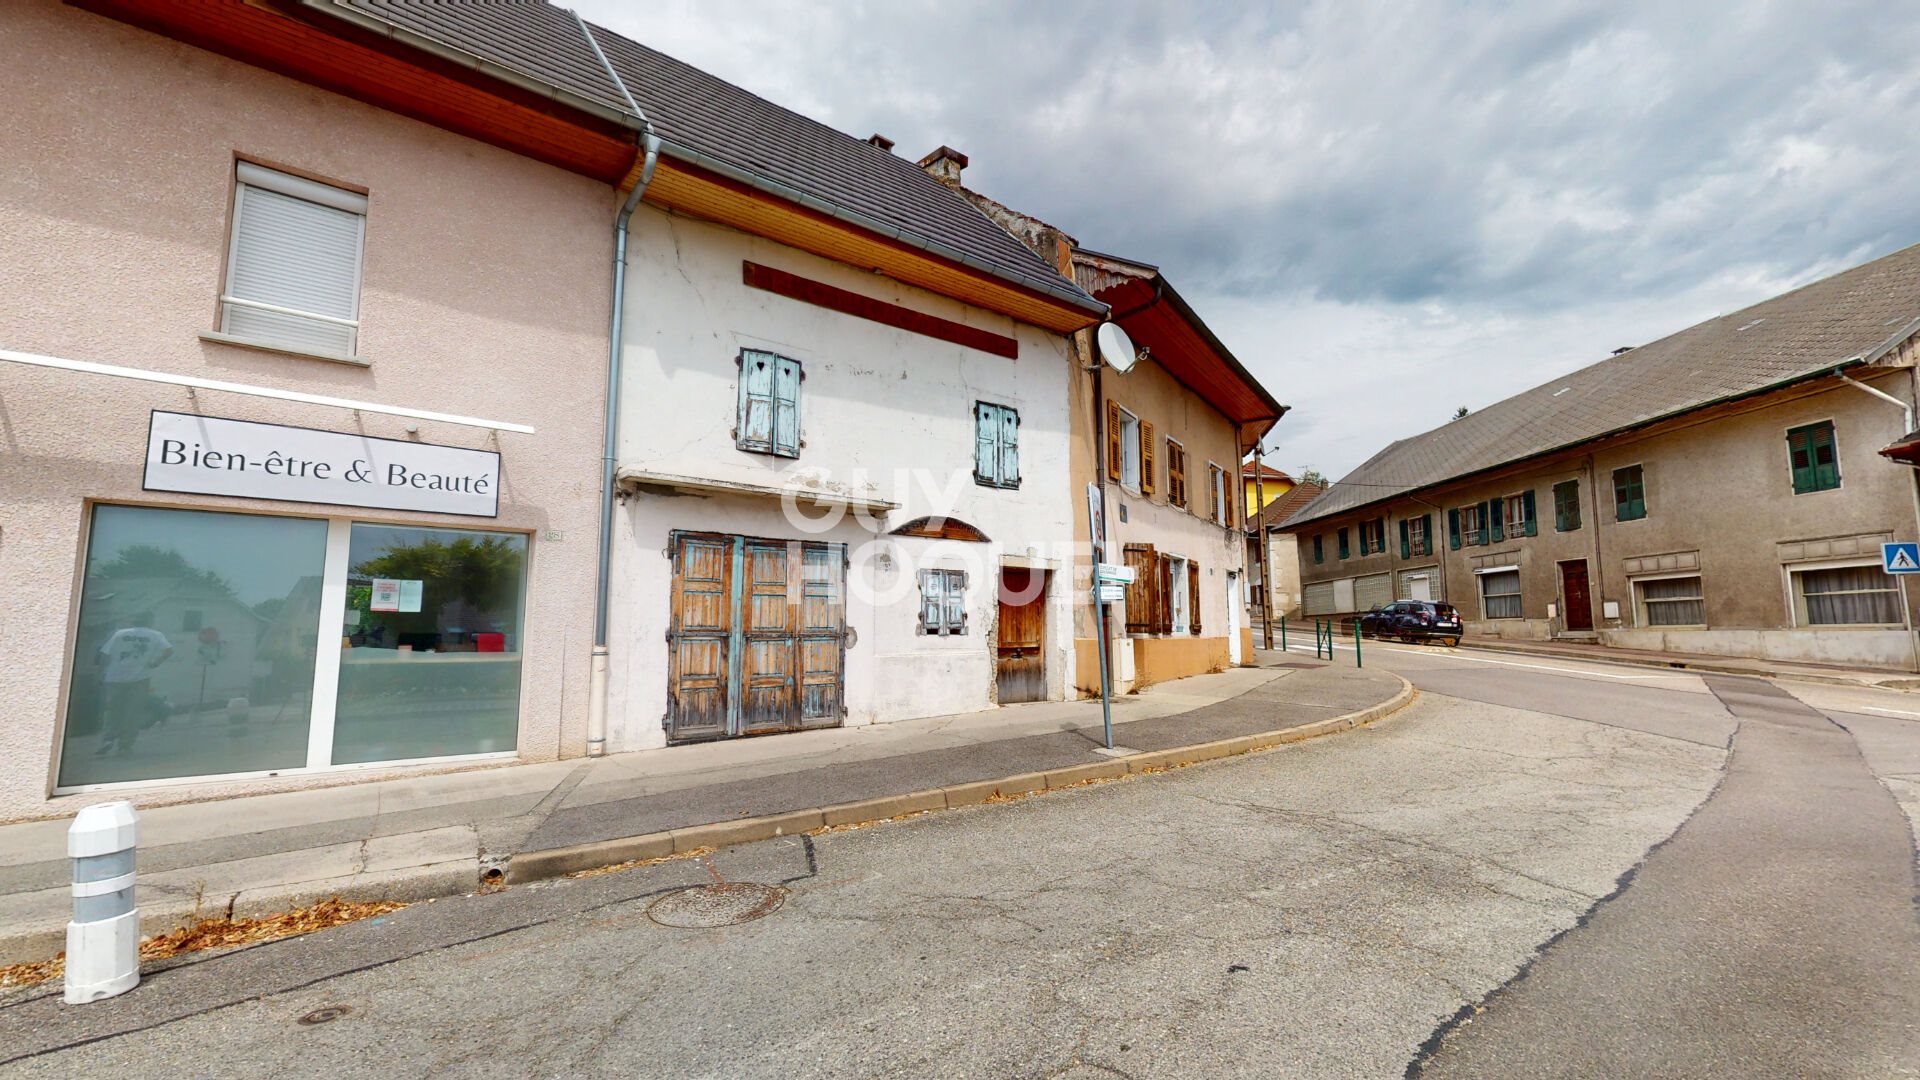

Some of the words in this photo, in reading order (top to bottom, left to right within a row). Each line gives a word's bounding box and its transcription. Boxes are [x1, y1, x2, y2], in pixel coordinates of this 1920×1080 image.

[161, 439, 332, 480] Bien-être
[344, 459, 372, 483] &
[388, 463, 489, 494] Beauté
